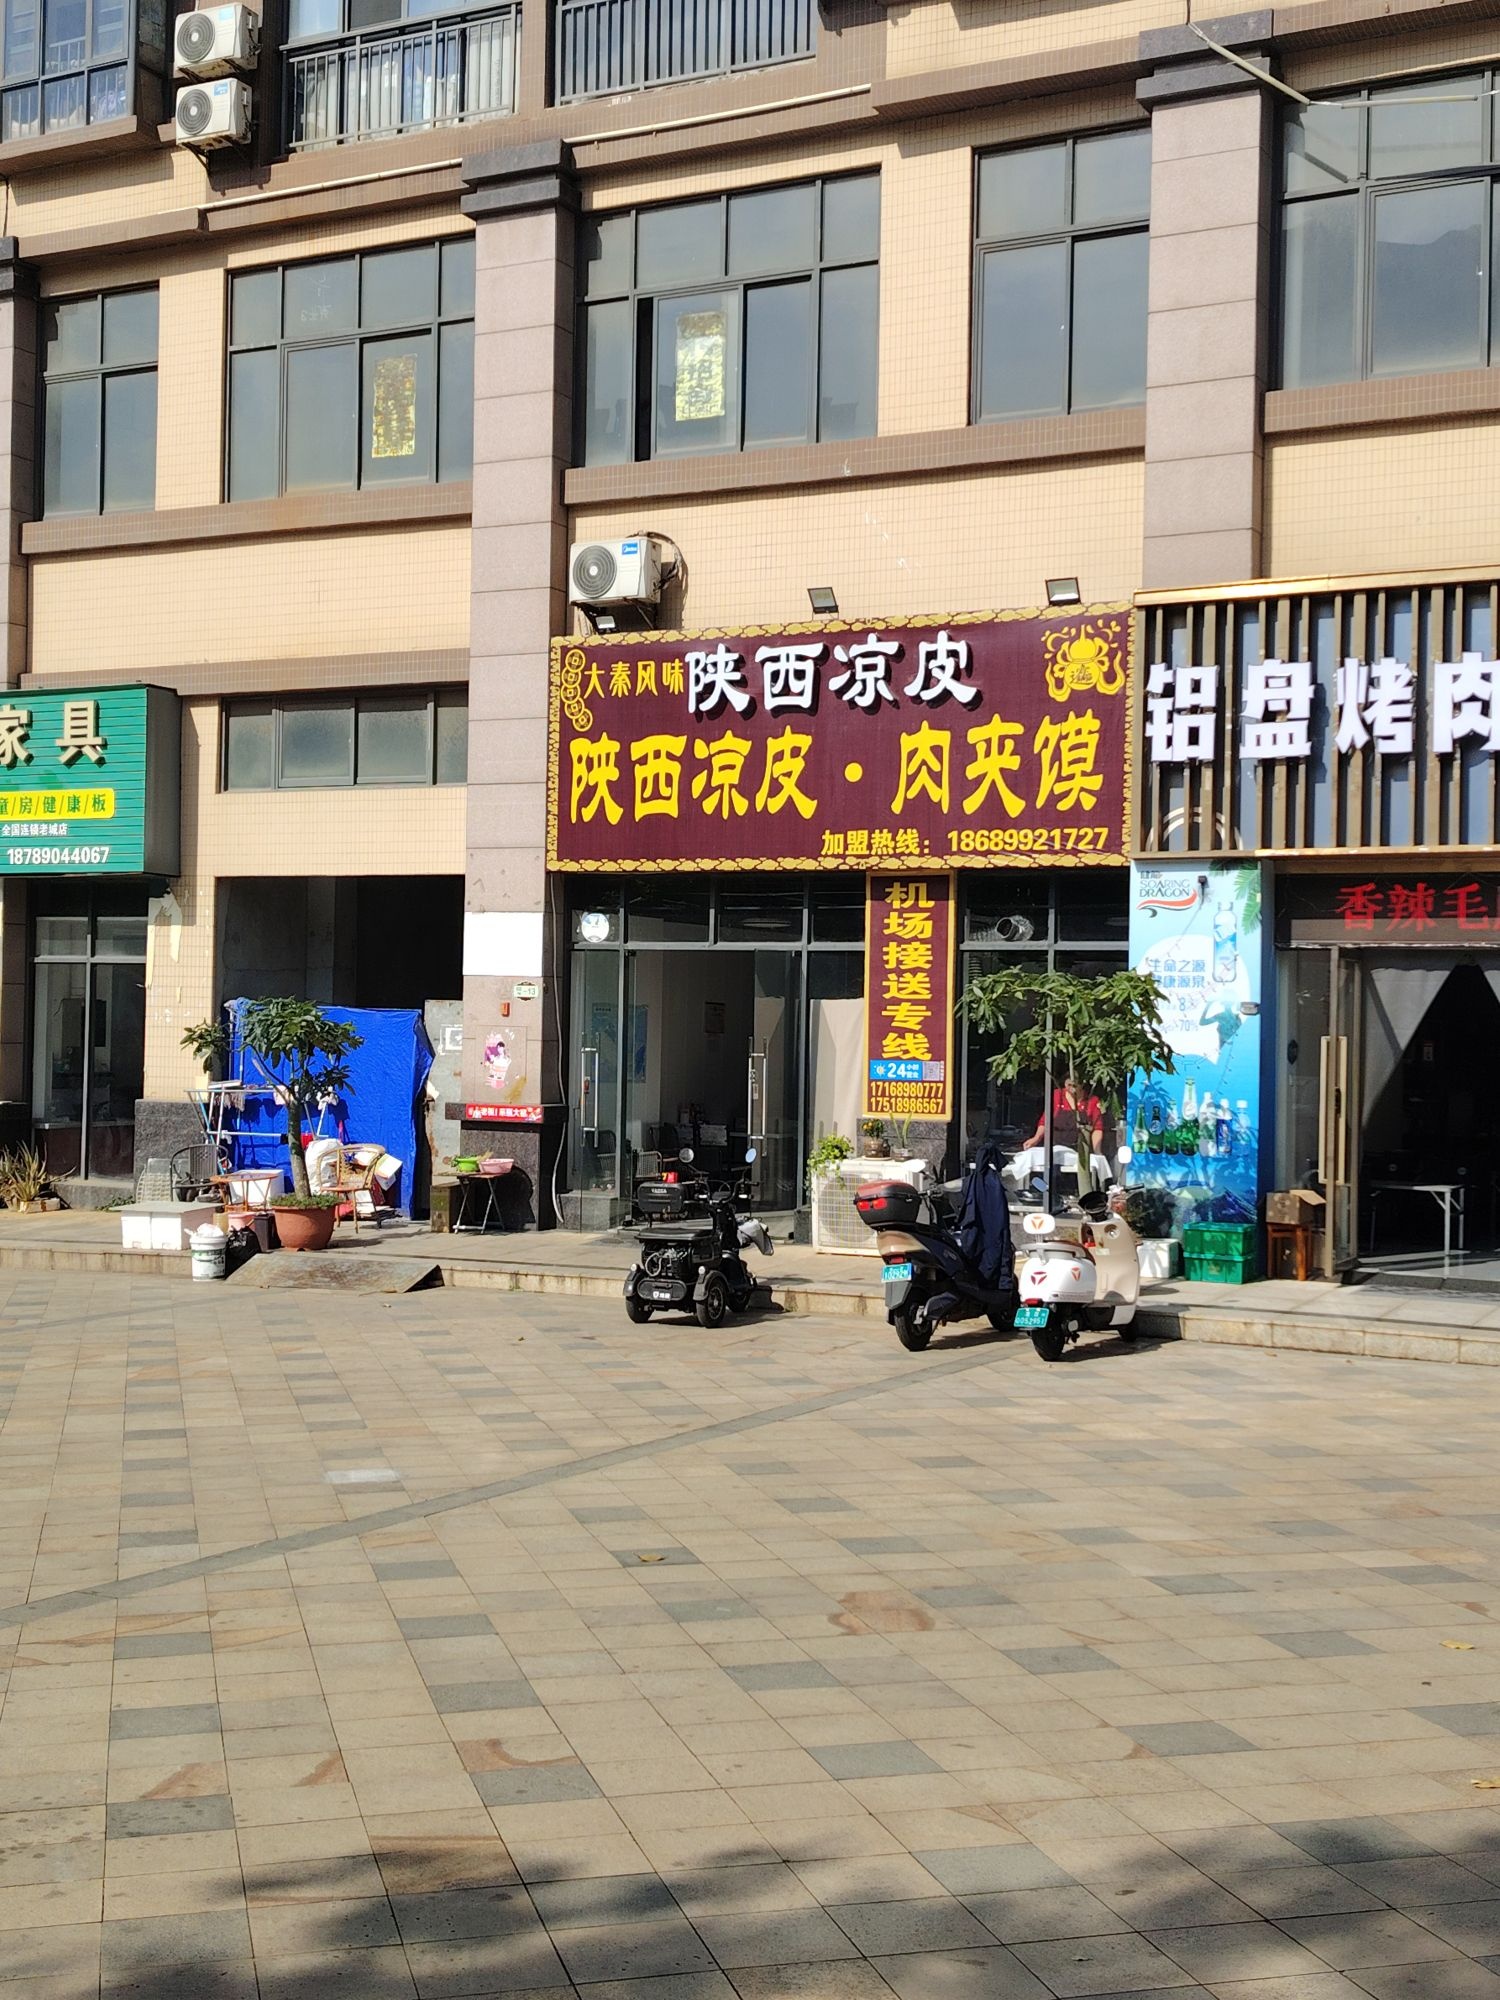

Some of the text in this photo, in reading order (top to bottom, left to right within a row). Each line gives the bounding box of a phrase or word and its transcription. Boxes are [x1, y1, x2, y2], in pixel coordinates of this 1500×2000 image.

[583, 658, 684, 699] 大秦风味
[685, 631, 979, 716] 陕西凉皮
[1145, 651, 1500, 762] 铝盘烤肉
[7, 847, 110, 865] 18789044067
[1140, 887, 1190, 897] DRAGON
[1336, 882, 1500, 933] 香辣毛
[881, 882, 936, 1061] 机场接送专线
[870, 1081, 944, 1098] 17168980777
[870, 1097, 943, 1113] 17518986567
